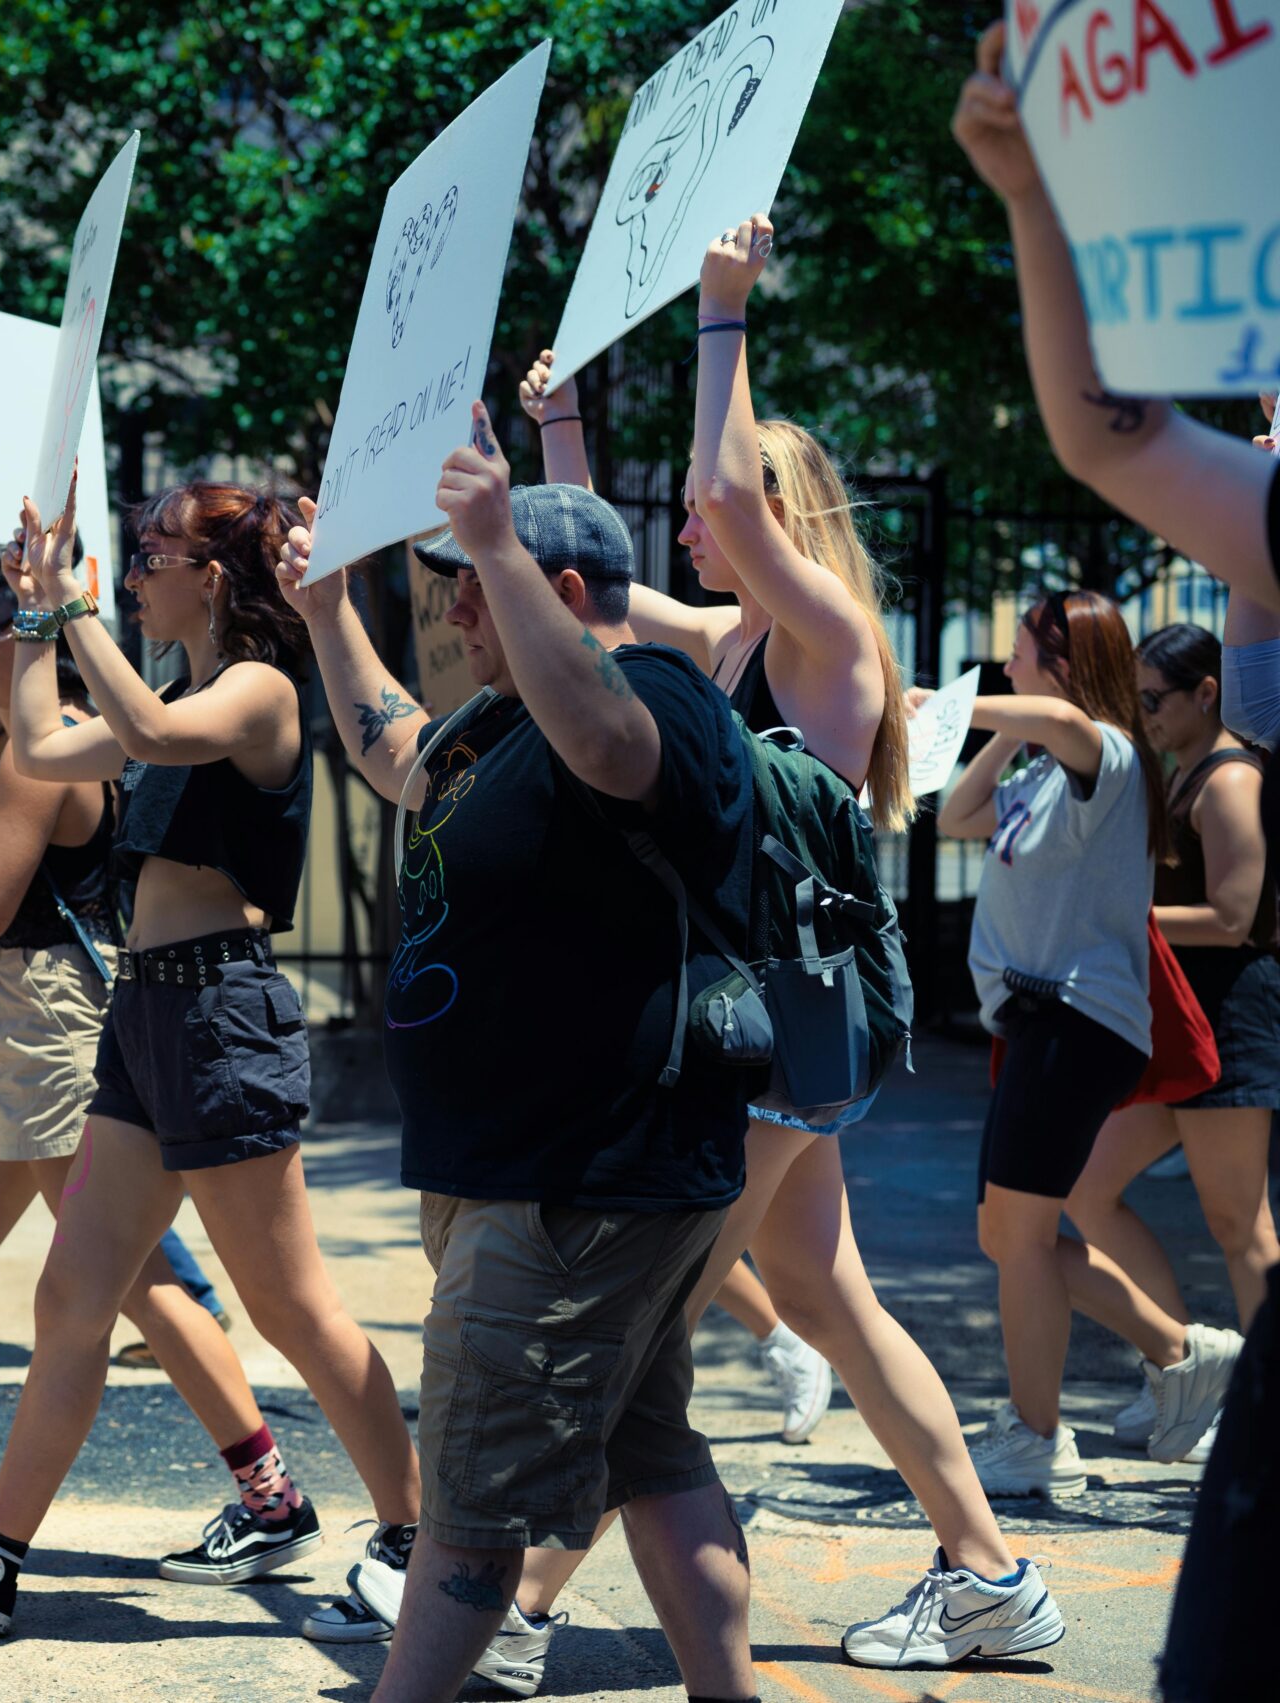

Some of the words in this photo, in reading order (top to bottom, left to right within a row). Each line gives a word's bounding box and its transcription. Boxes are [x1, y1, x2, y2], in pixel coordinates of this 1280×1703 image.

[672, 10, 738, 98] TREAD
[361, 401, 407, 474] TREAD
[410, 378, 434, 431] ON
